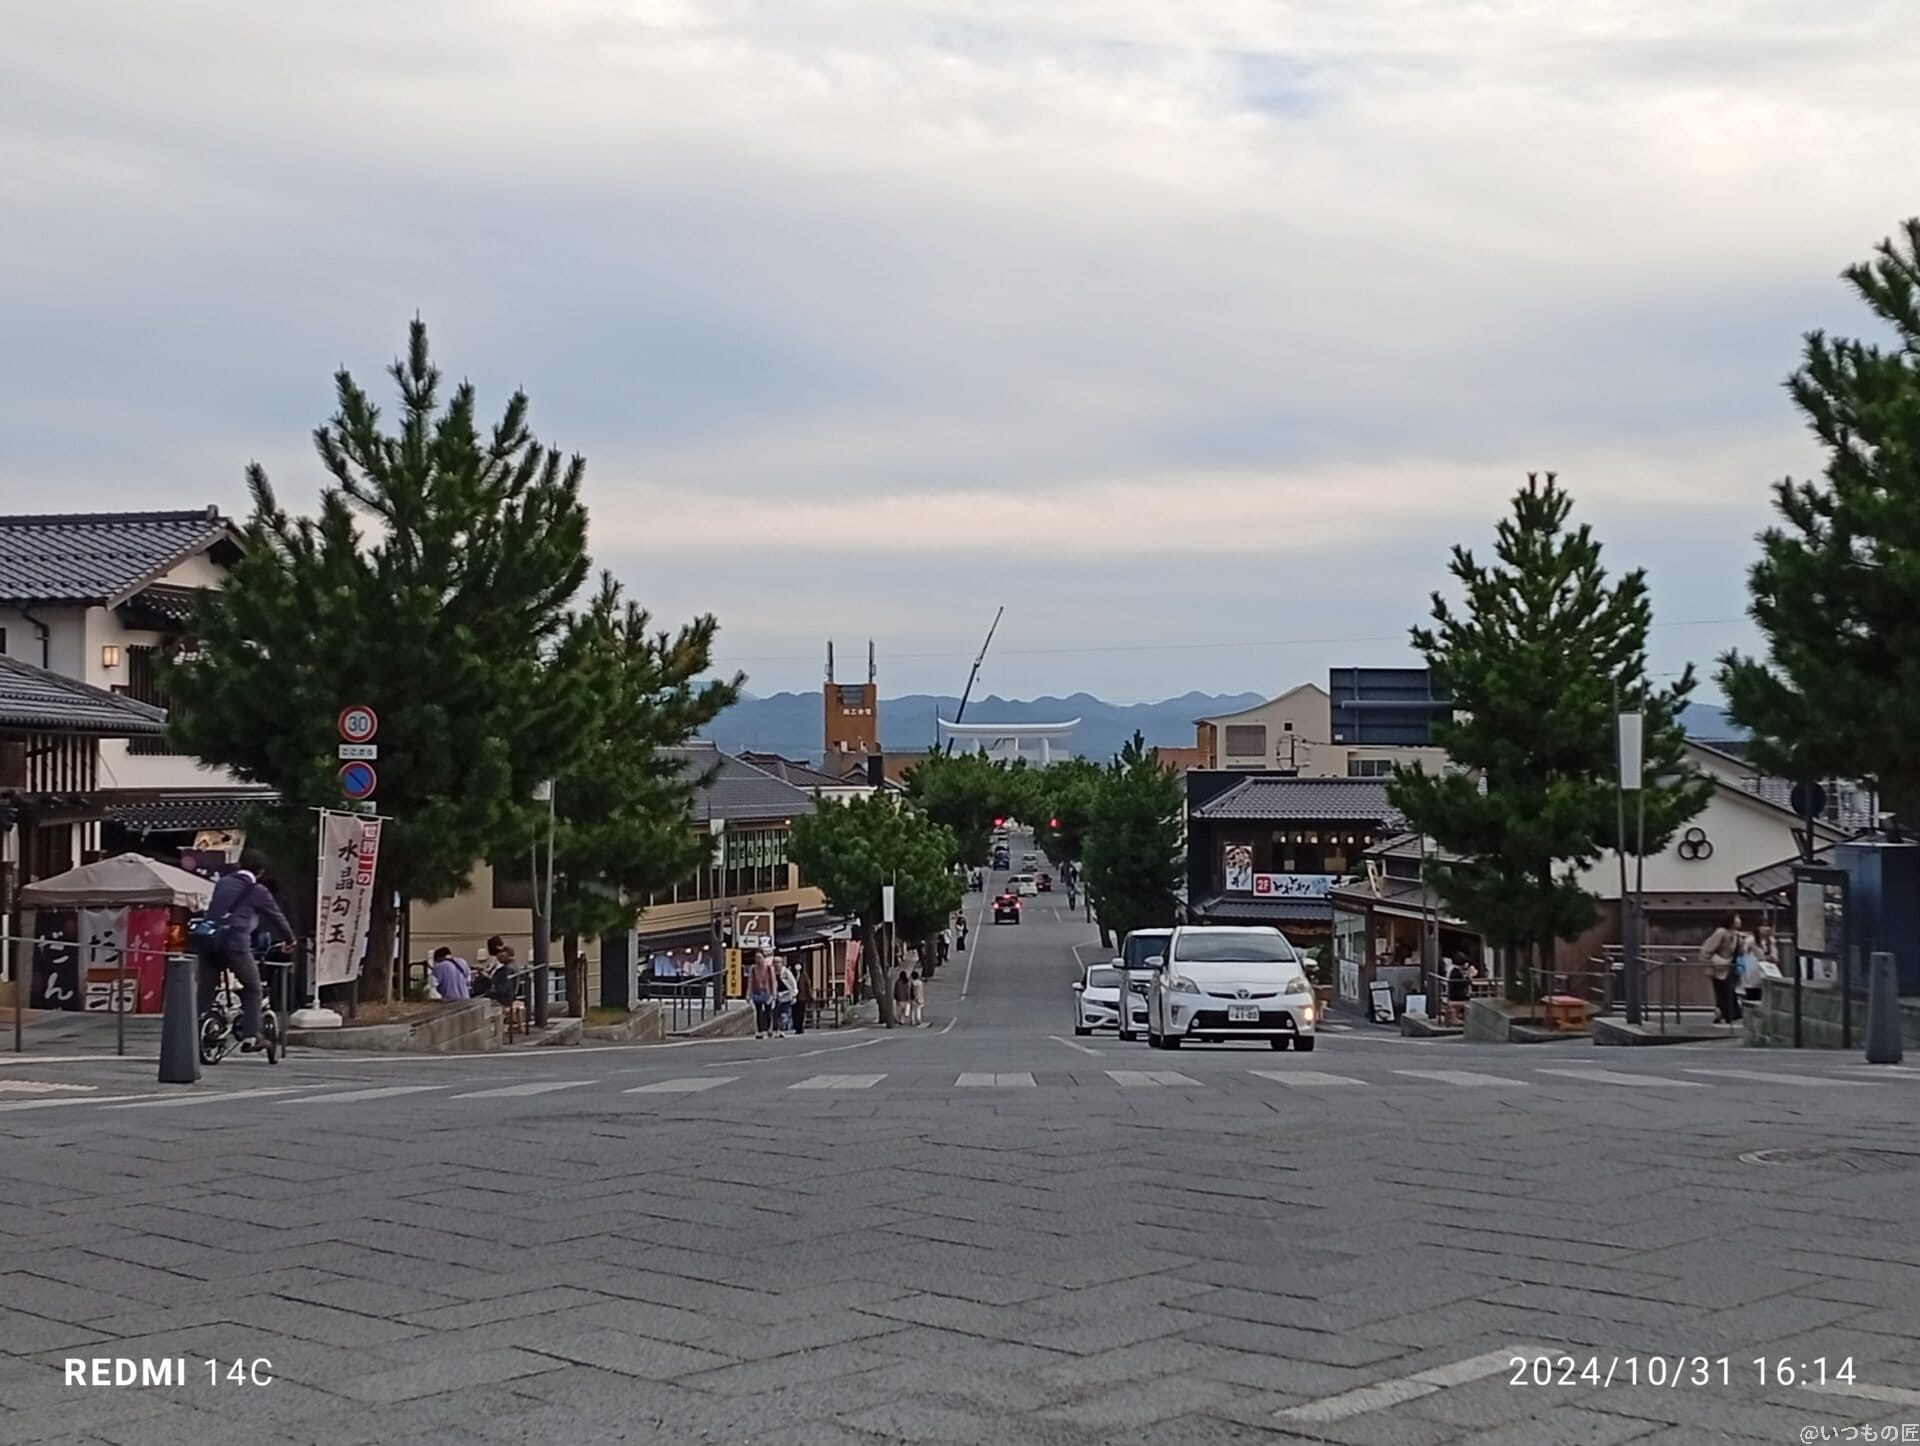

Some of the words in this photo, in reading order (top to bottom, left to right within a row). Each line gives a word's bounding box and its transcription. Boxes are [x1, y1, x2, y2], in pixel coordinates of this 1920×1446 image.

[348, 715, 368, 732] 30
[326, 838, 358, 944] 水晶勾玉
